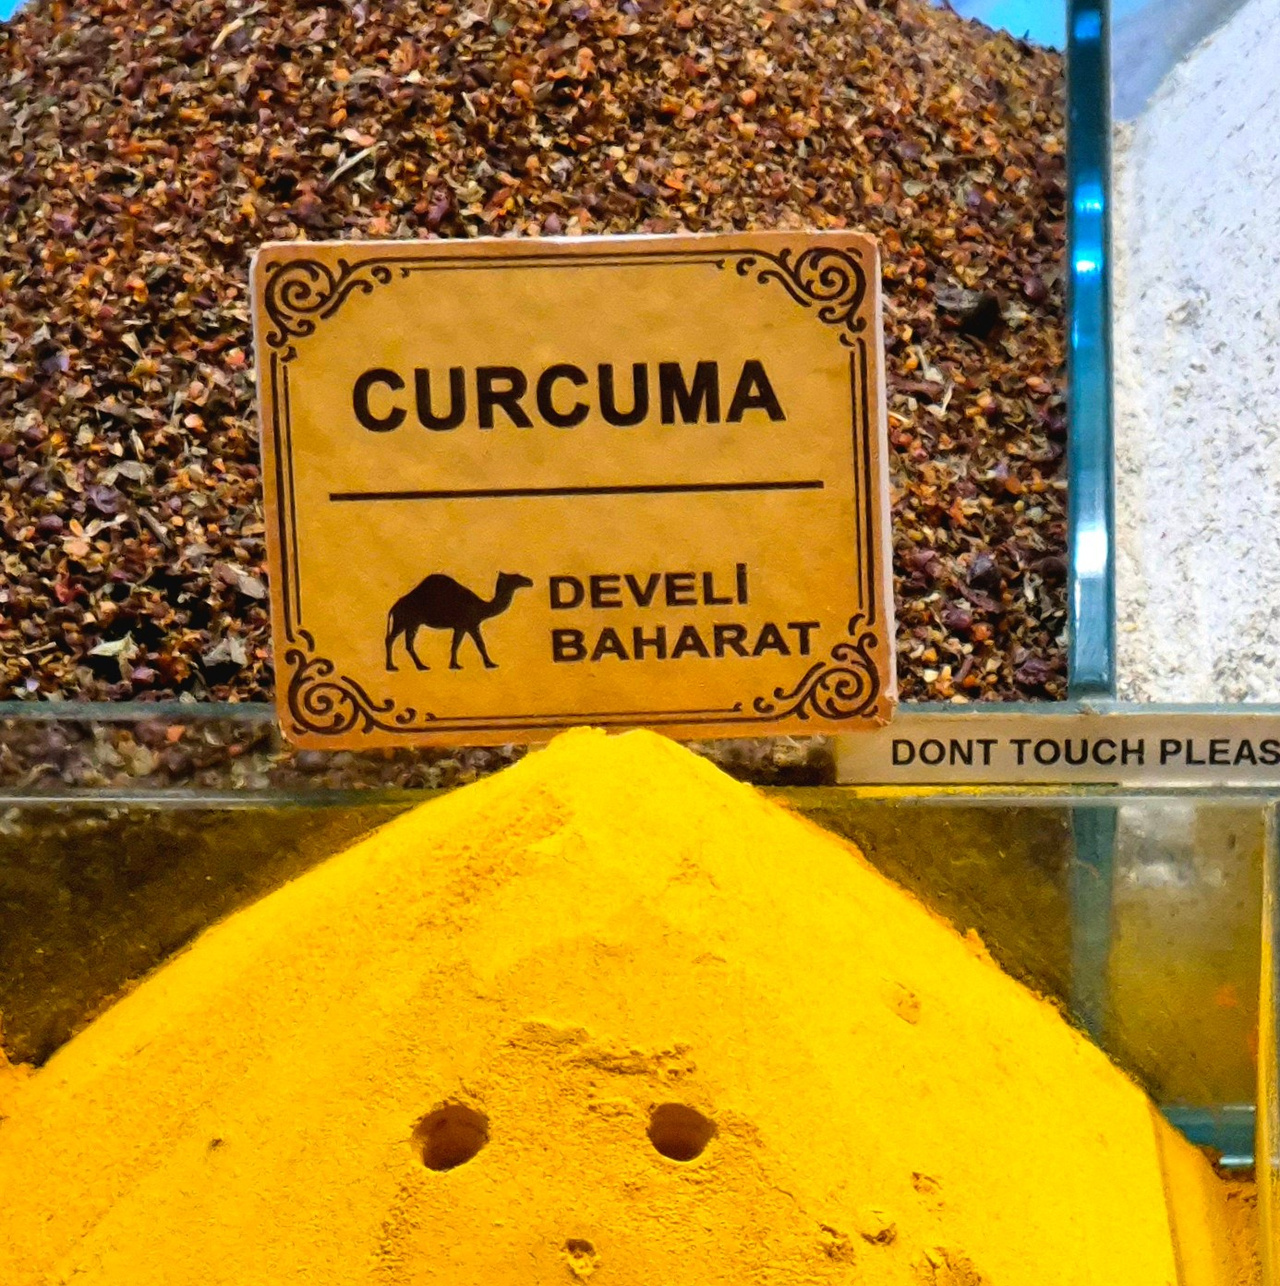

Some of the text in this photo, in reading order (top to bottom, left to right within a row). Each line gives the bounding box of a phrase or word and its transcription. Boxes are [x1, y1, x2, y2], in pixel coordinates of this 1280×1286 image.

[352, 359, 787, 433] CURCUMA
[551, 622, 820, 663] BAHARAT
[891, 738, 998, 766] DONT
[1009, 738, 1145, 766] TOUCH
